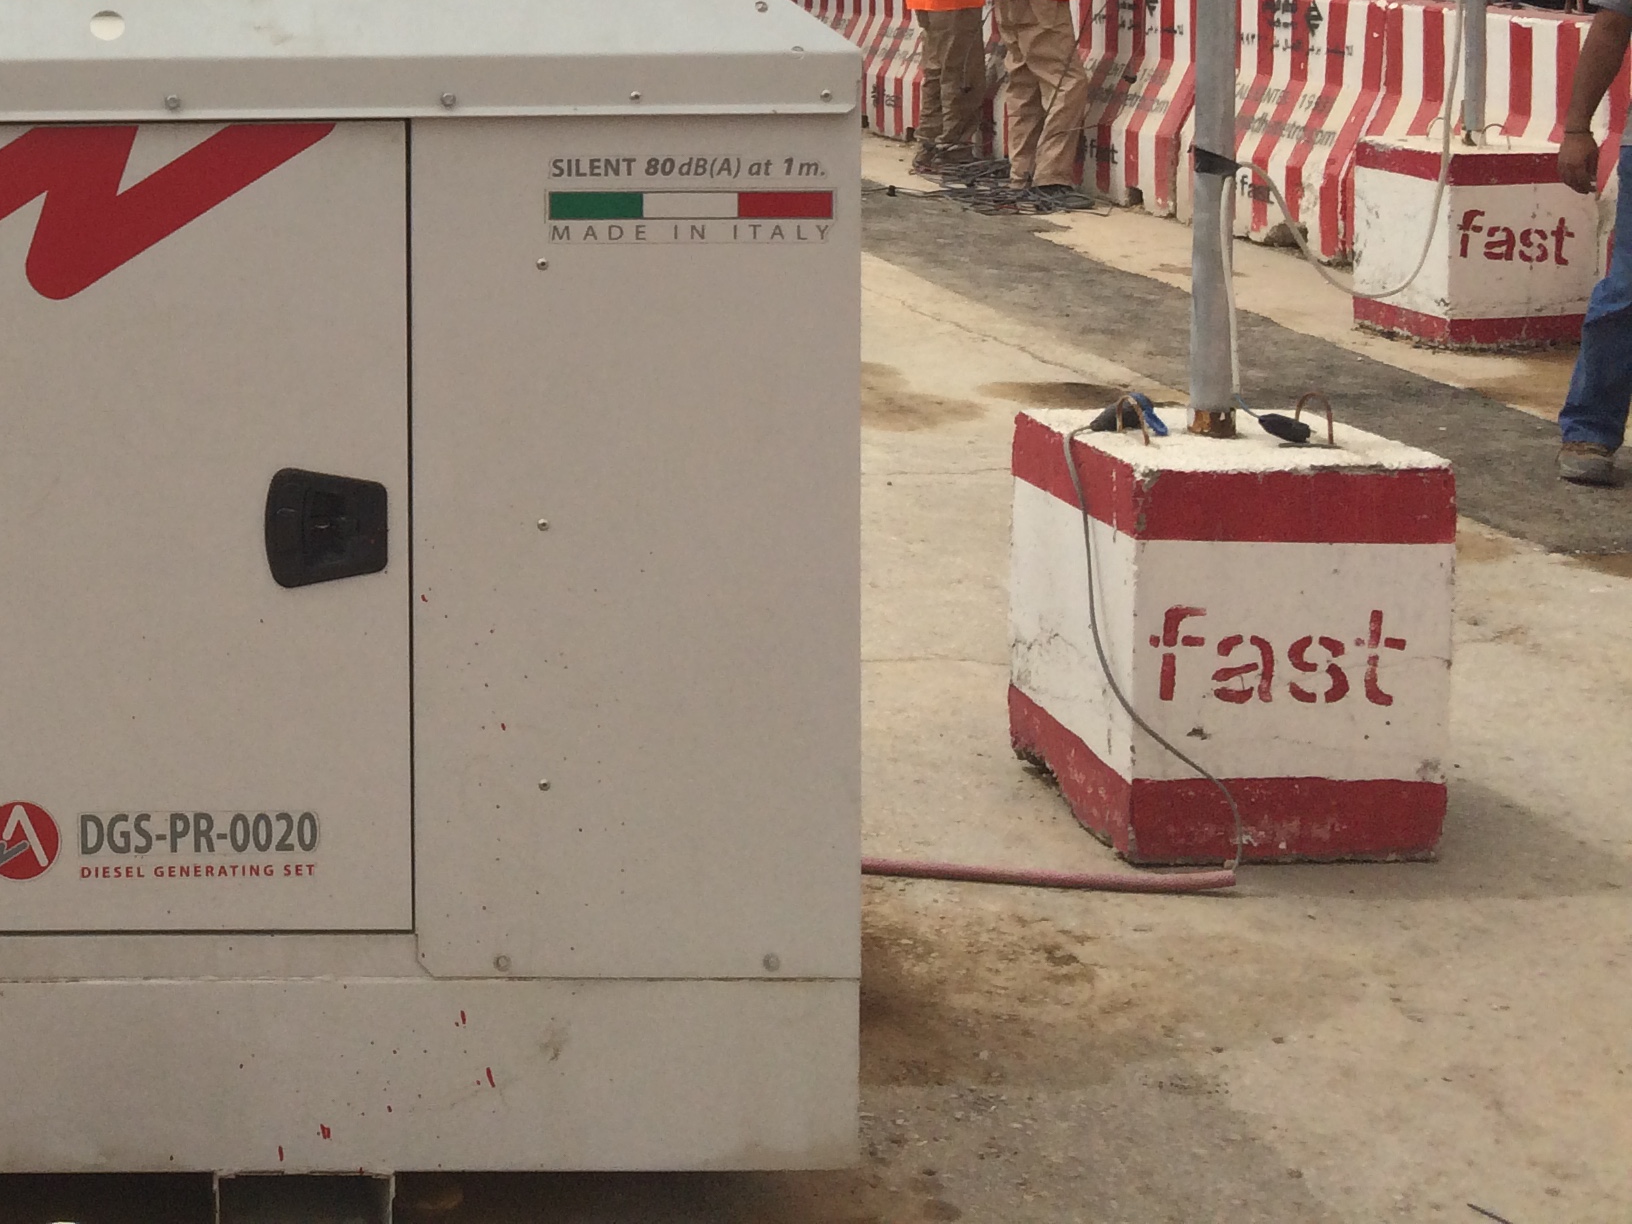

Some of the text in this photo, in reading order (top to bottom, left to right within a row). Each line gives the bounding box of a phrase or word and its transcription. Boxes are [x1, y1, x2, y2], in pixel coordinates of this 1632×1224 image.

[551, 157, 636, 178] SILENT
[748, 158, 773, 177] at
[551, 224, 830, 241] MADE IN ITALY
[1457, 209, 1576, 266] fast
[1148, 604, 1407, 707] fast
[79, 812, 318, 855] DGS-PR-0020
[80, 863, 315, 878] DIESEL GENERATING SET
